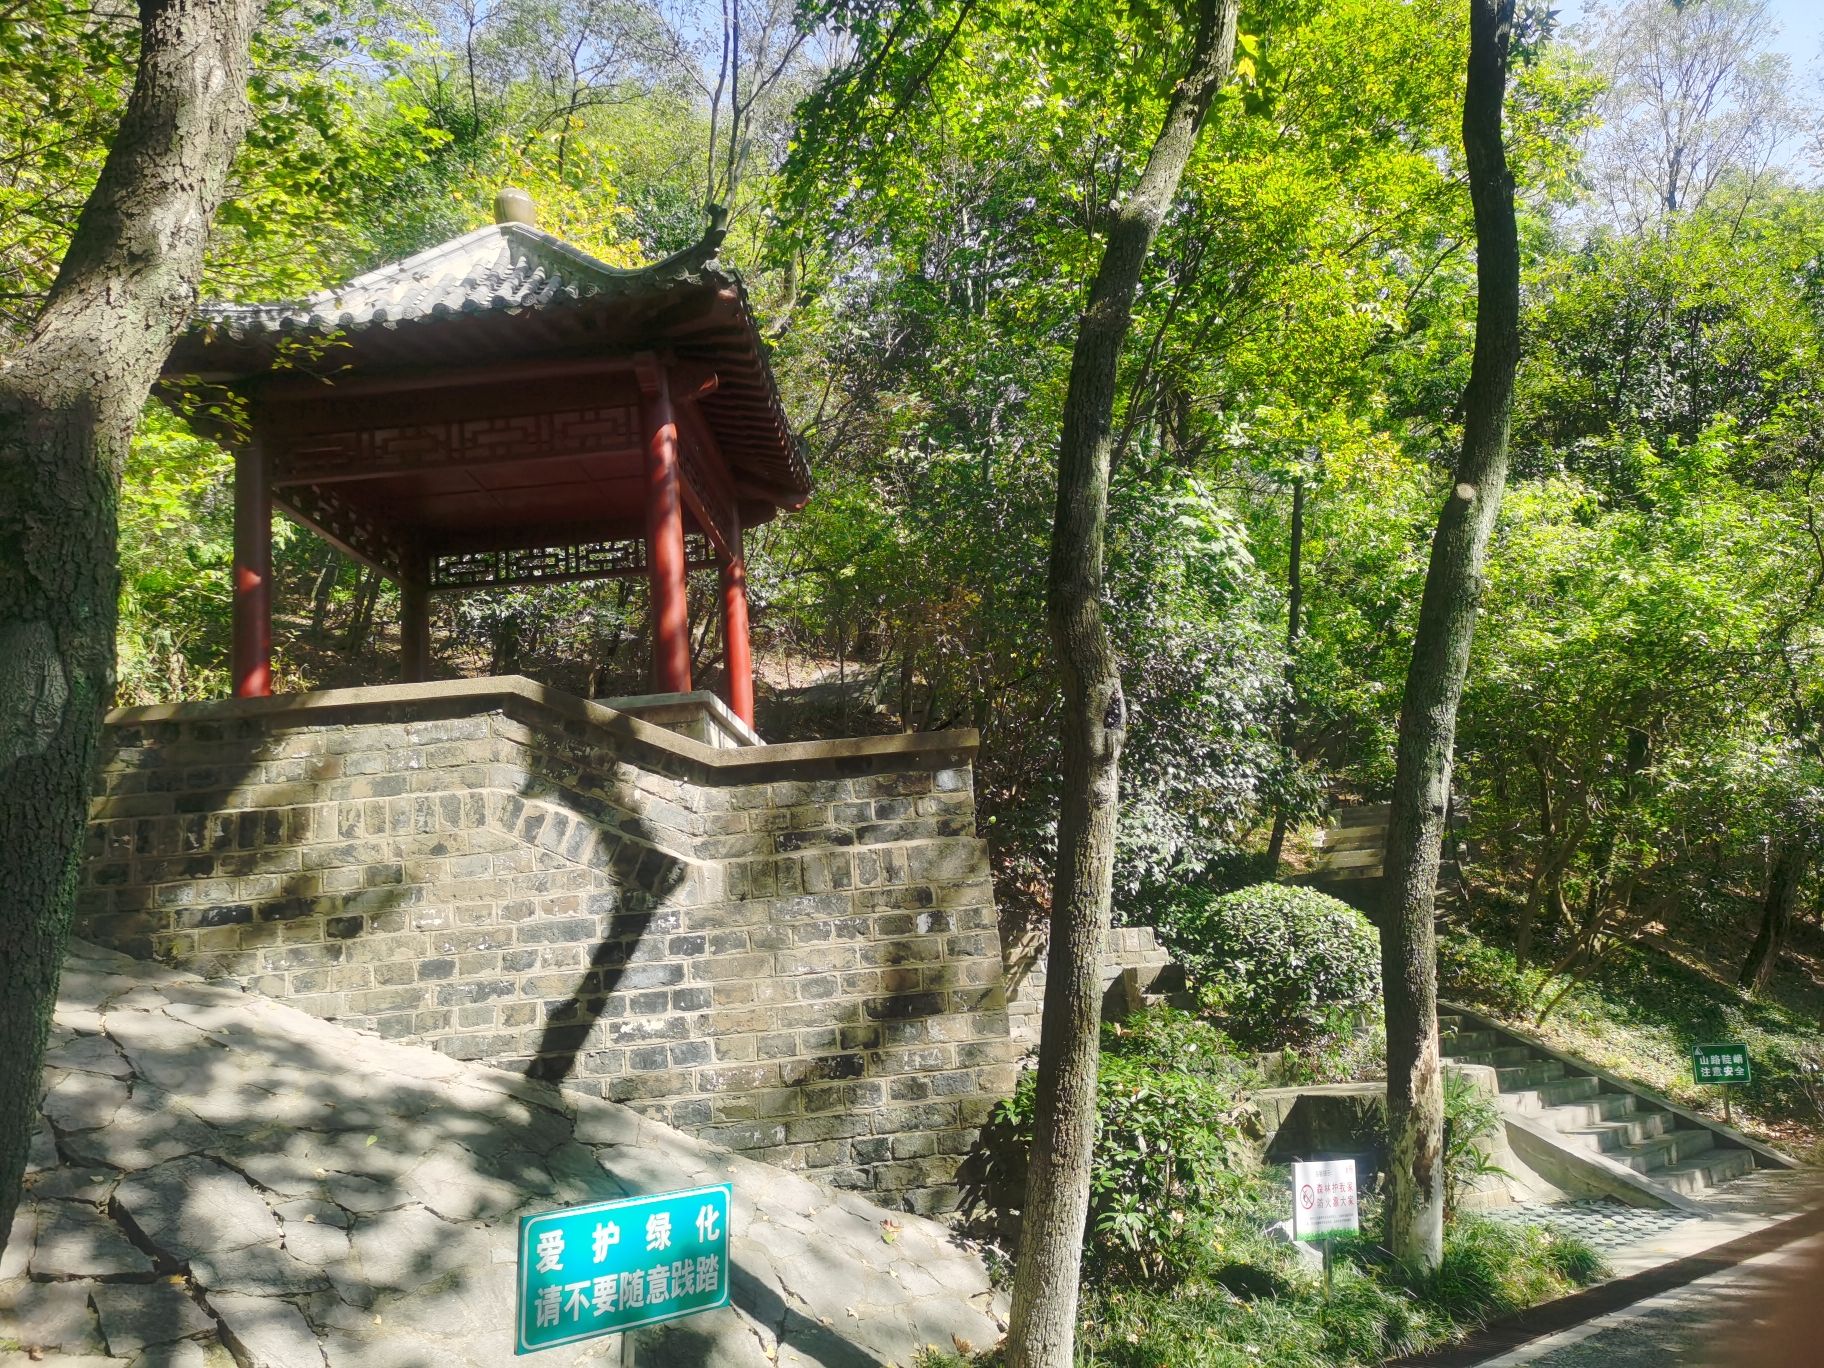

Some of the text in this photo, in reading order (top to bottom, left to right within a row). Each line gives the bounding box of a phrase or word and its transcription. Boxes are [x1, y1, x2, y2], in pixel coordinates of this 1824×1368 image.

[1699, 1054, 1743, 1065] 山路陡峭
[1701, 1066, 1745, 1077] 注意安全
[535, 1204, 720, 1273] 爱护绿化
[534, 1253, 719, 1328] 请不要随意践踏
